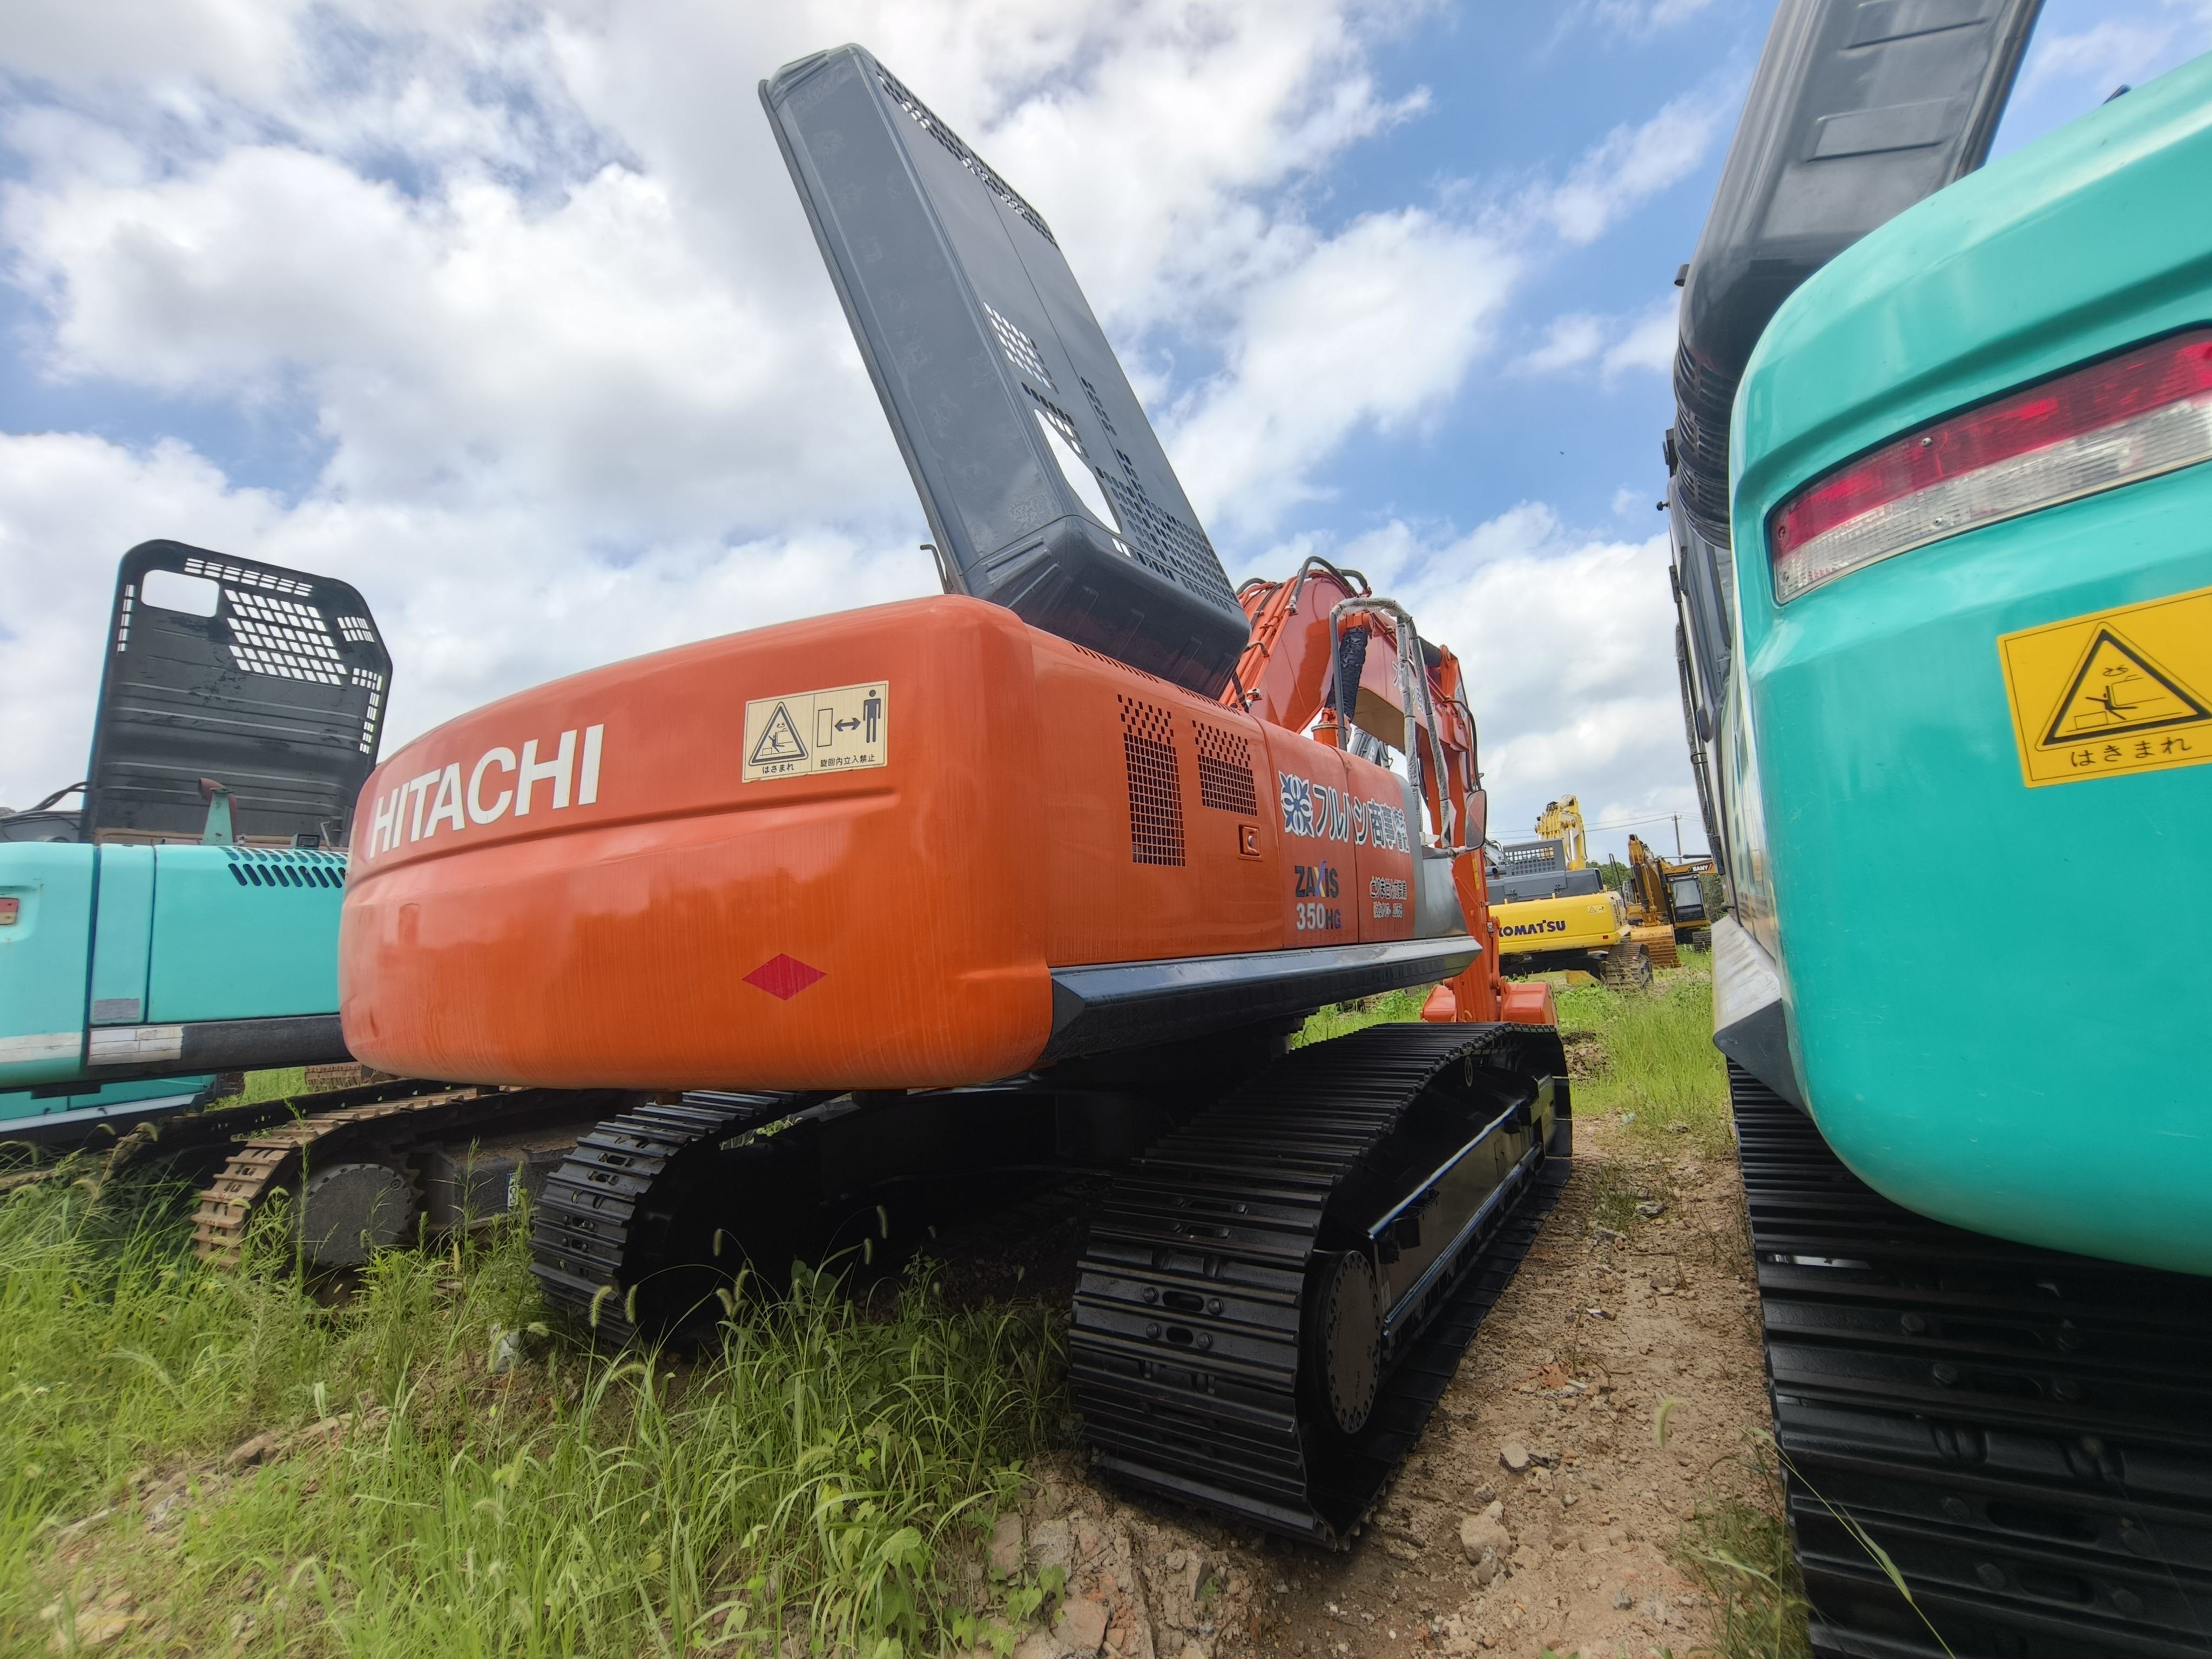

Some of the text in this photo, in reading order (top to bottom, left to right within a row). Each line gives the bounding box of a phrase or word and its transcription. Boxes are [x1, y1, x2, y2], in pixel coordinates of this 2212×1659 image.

[762, 763, 794, 773] はさまれ
[820, 754, 875, 767] 旋回内立入禁止
[369, 724, 604, 859] HITACHI
[1294, 860, 1339, 898] ZAXIS
[1296, 902, 1341, 930] 350HG
